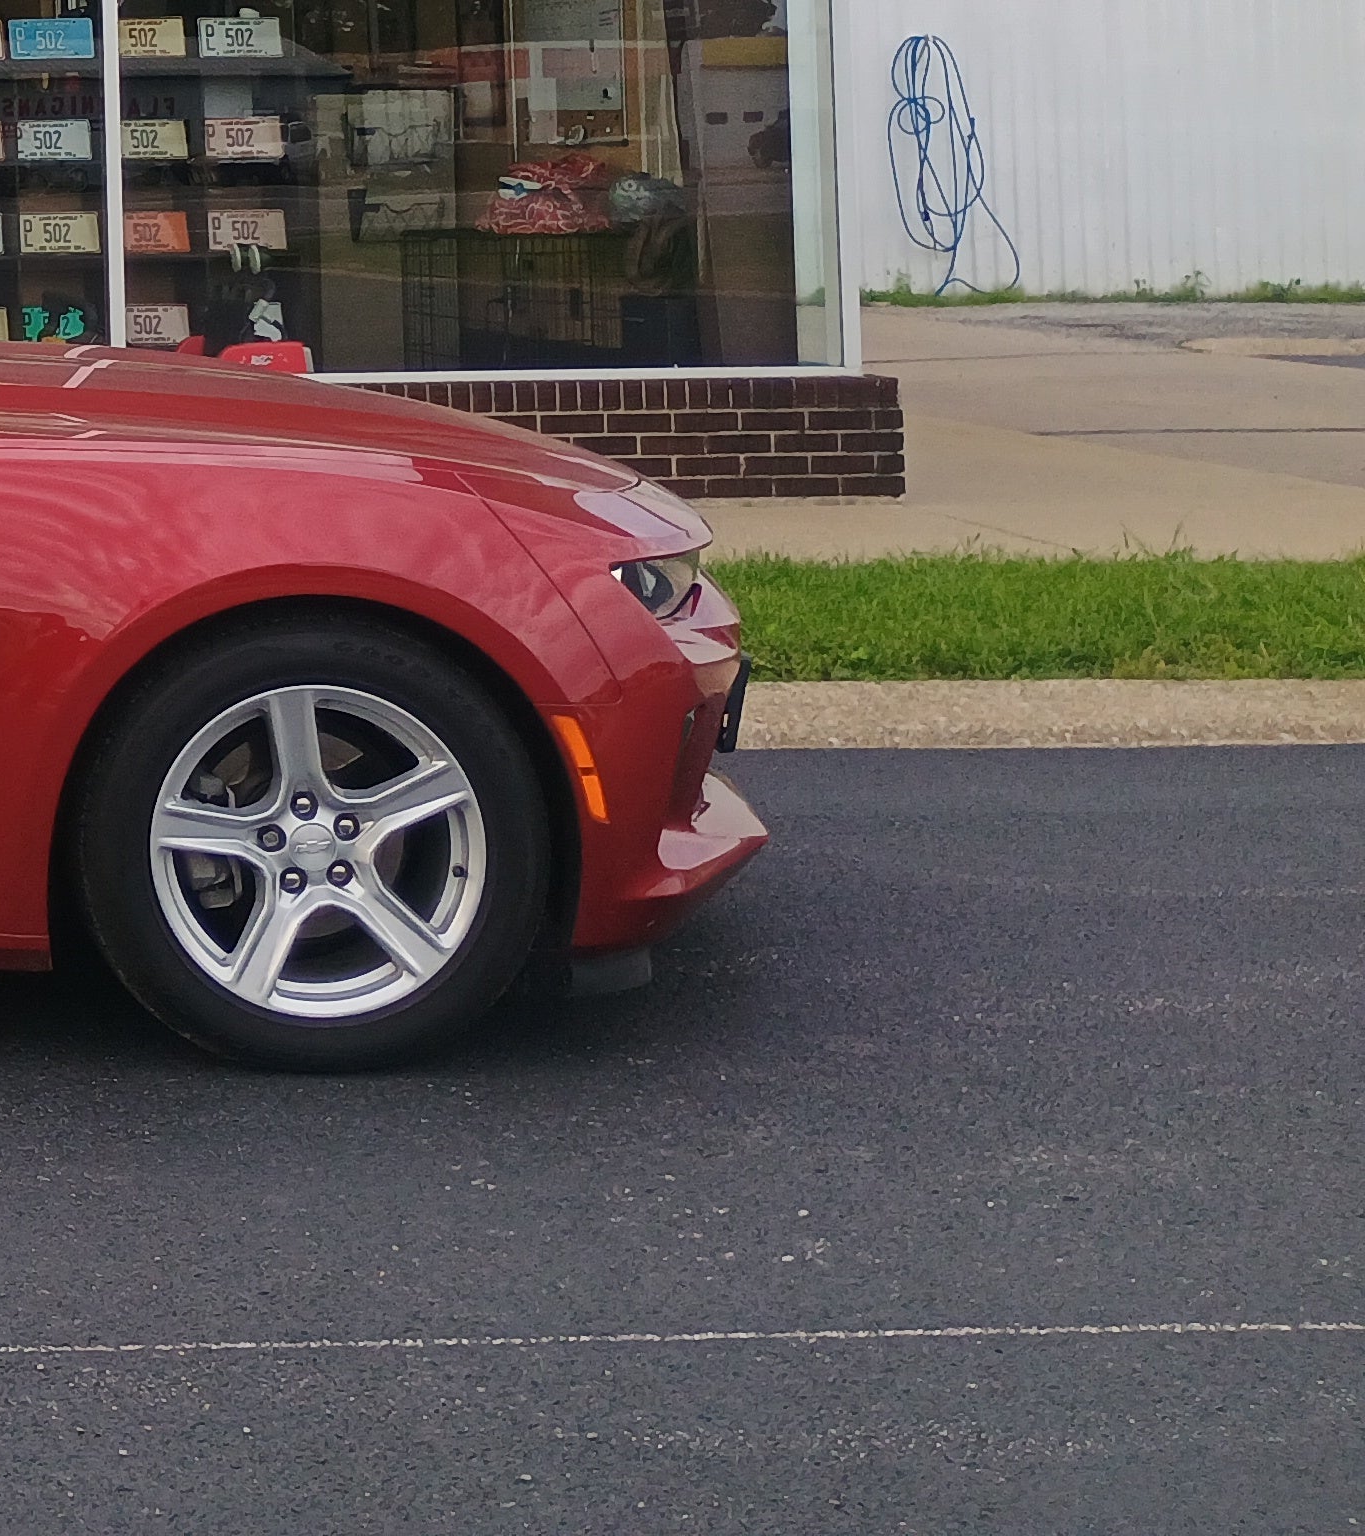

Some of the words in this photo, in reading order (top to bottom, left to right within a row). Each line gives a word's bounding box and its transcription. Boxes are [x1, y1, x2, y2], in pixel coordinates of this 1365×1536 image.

[36, 30, 66, 50] 502
[129, 28, 157, 47] 502
[225, 28, 254, 47] 502
[34, 130, 62, 150] 502
[130, 129, 159, 148] 502
[226, 128, 254, 147] 502
[43, 223, 71, 243] 502
[133, 223, 161, 242] 502
[232, 221, 260, 240] 502
[134, 315, 162, 334] 502
